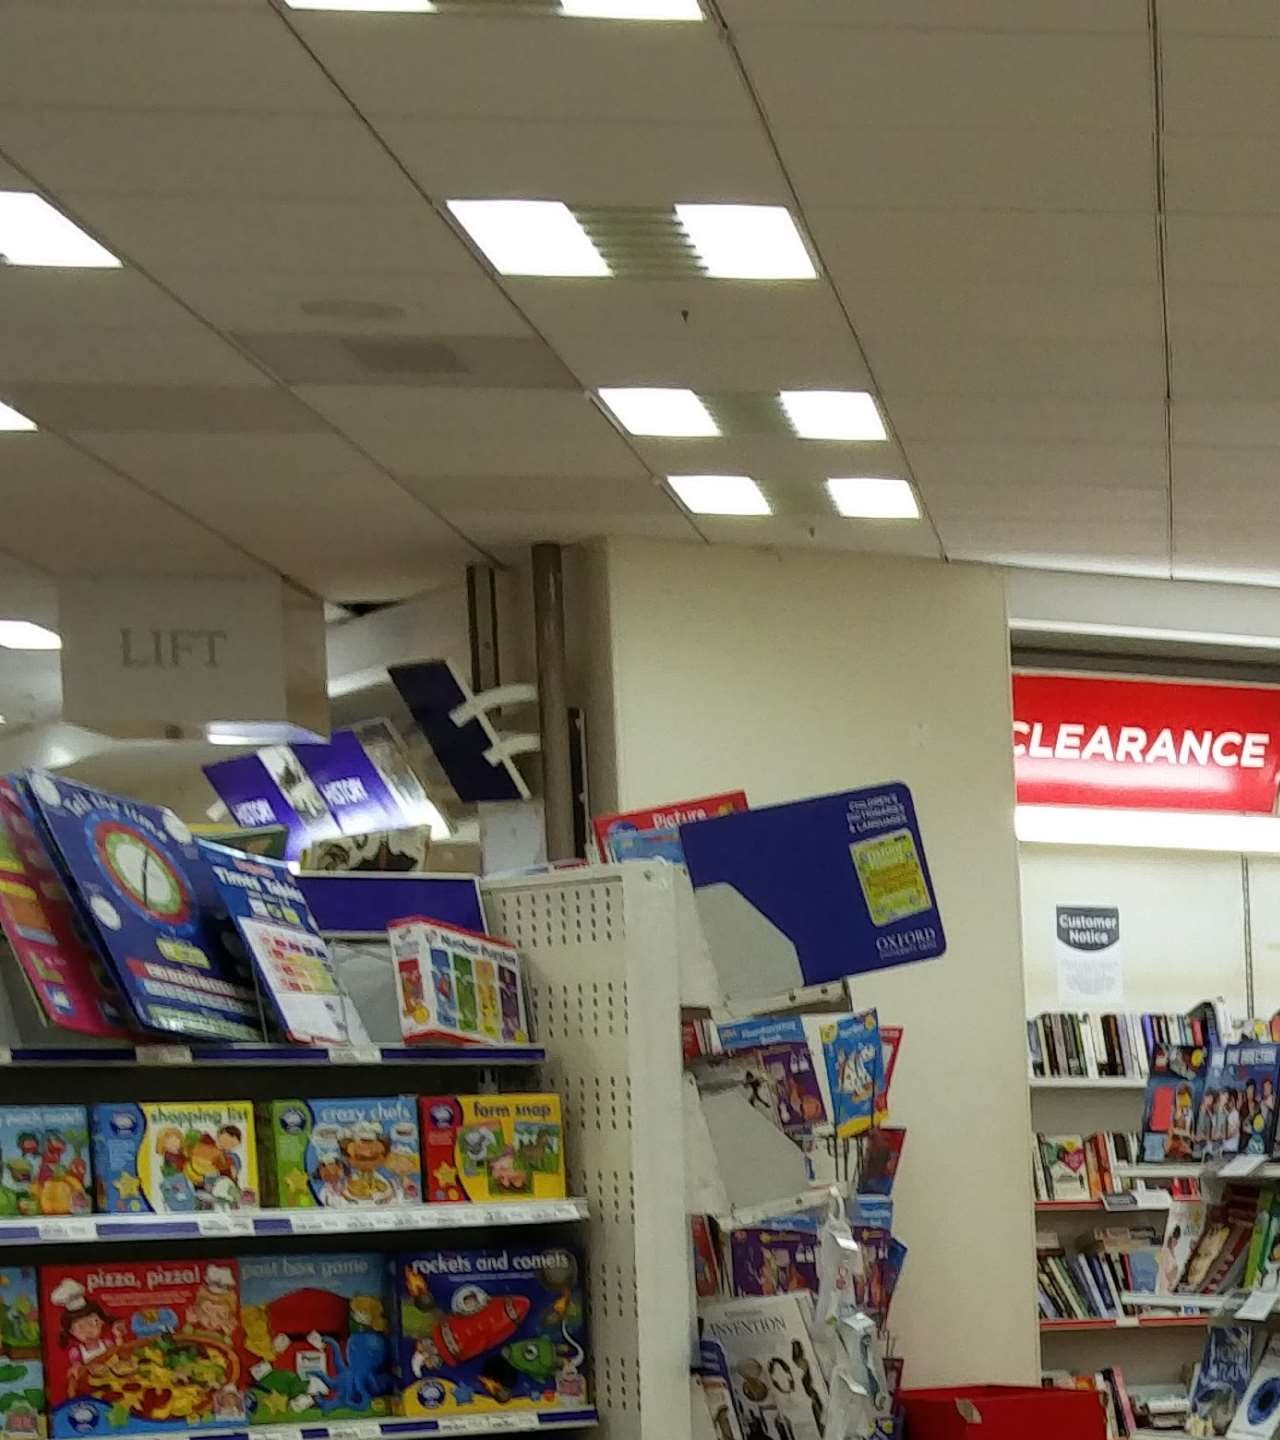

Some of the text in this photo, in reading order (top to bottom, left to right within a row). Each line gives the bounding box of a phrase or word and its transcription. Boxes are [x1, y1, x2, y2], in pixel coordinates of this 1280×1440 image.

[119, 627, 227, 669] LIFT
[1013, 722, 1270, 769] CLEARANCE
[653, 806, 706, 829] Picture
[1058, 913, 1118, 932] Customer
[876, 927, 936, 951] OXFORD
[1068, 929, 1109, 946] Notice
[151, 1107, 248, 1126] shopping list
[370, 1101, 411, 1120] chefs
[474, 1101, 551, 1120] farm snap
[282, 1255, 315, 1275] box
[411, 1251, 569, 1275] rockets and comets
[709, 1315, 787, 1337] INVENTION
